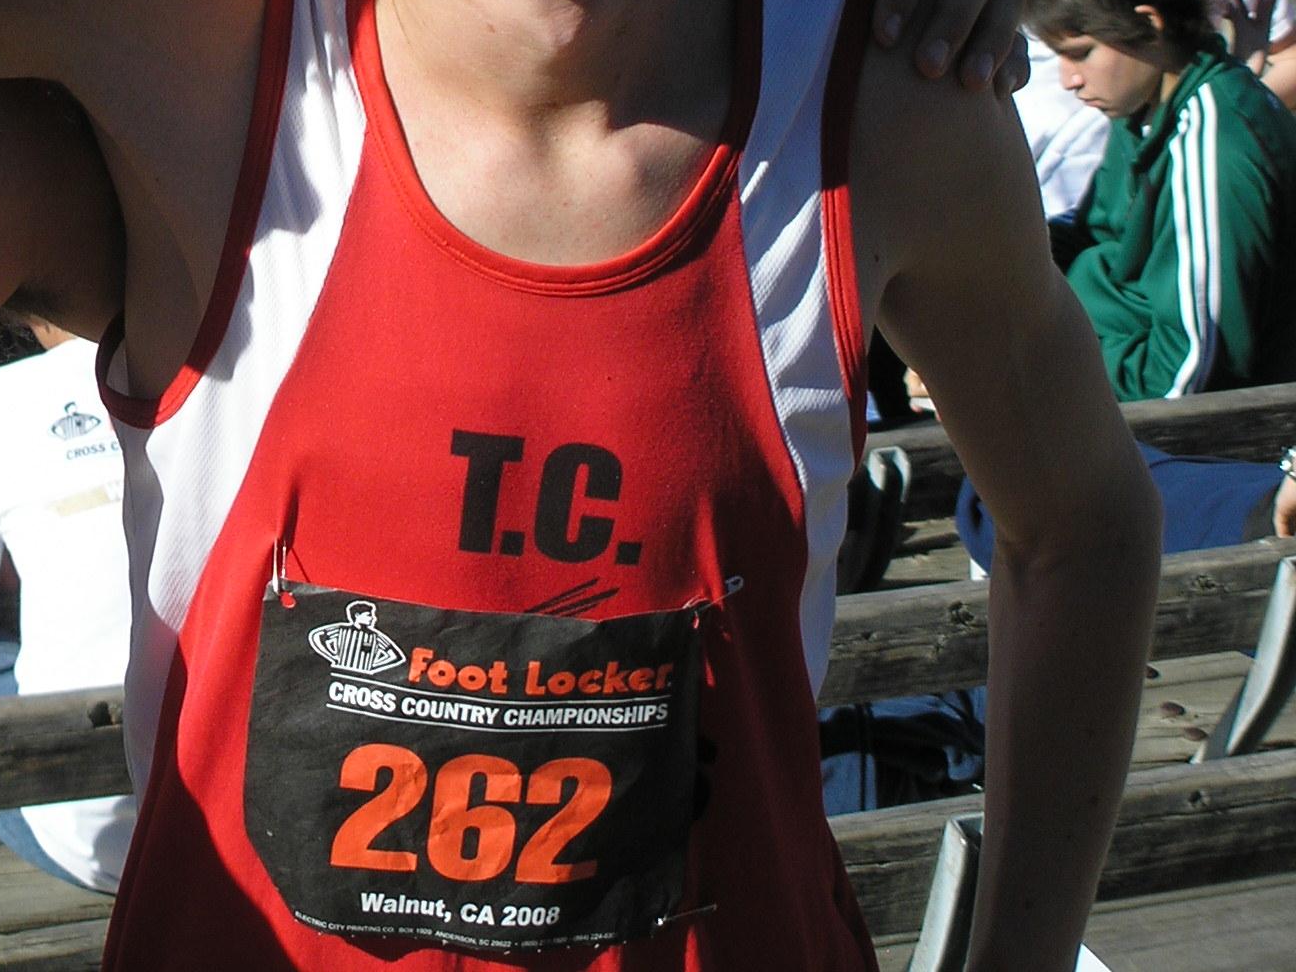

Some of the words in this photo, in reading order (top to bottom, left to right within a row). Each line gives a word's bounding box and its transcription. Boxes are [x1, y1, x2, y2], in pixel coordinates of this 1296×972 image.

[65, 442, 106, 460] CROSS
[450, 428, 644, 567] T.C.
[408, 646, 508, 696] Foot
[524, 660, 674, 696] Locker
[328, 681, 397, 713] CROSS
[401, 696, 500, 726] COUNTRY
[503, 702, 669, 727] CHAMPIONSHIPS
[330, 742, 613, 885] 262
[294, 910, 327, 929] ELECTRIC
[328, 922, 345, 931] CITY
[346, 924, 381, 933] PRINTING
[360, 891, 452, 923] Walnut,
[460, 902, 495, 925] CA
[501, 905, 561, 927] 2008
